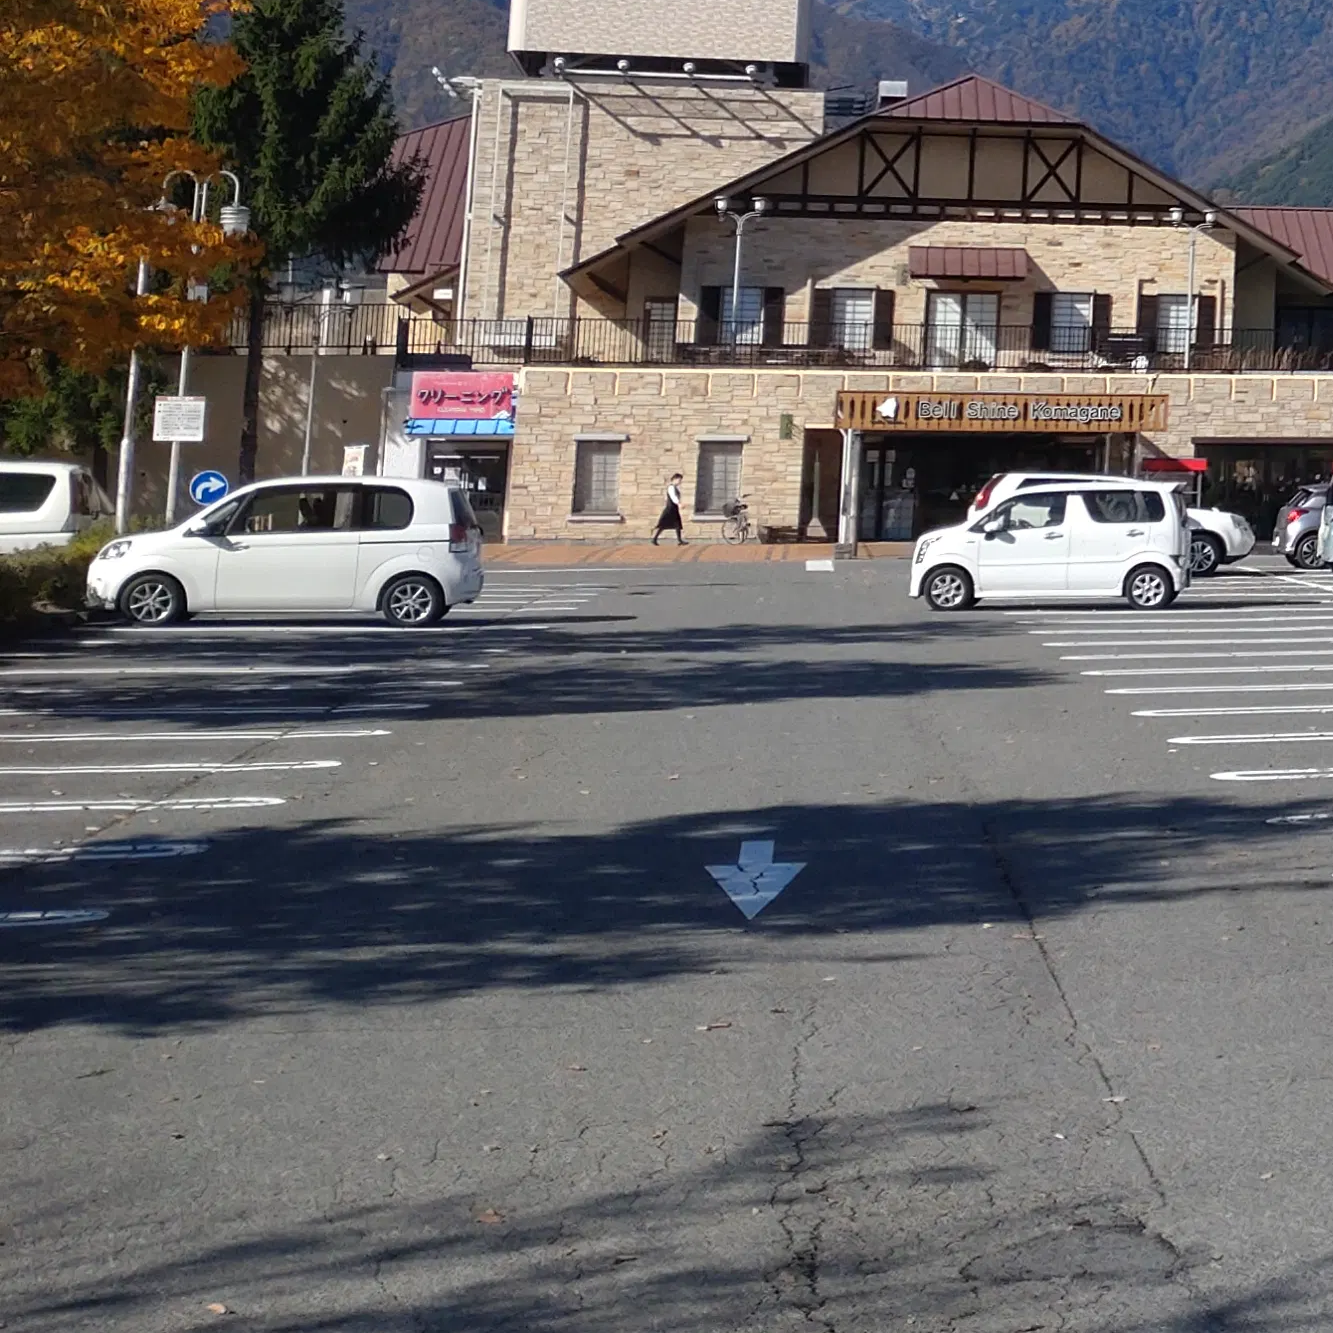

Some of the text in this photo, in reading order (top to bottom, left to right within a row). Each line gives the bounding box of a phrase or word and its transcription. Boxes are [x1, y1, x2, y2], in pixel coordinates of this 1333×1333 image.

[417, 387, 508, 404] クリーニング
[918, 401, 1122, 424] Bell Shine Komagane
